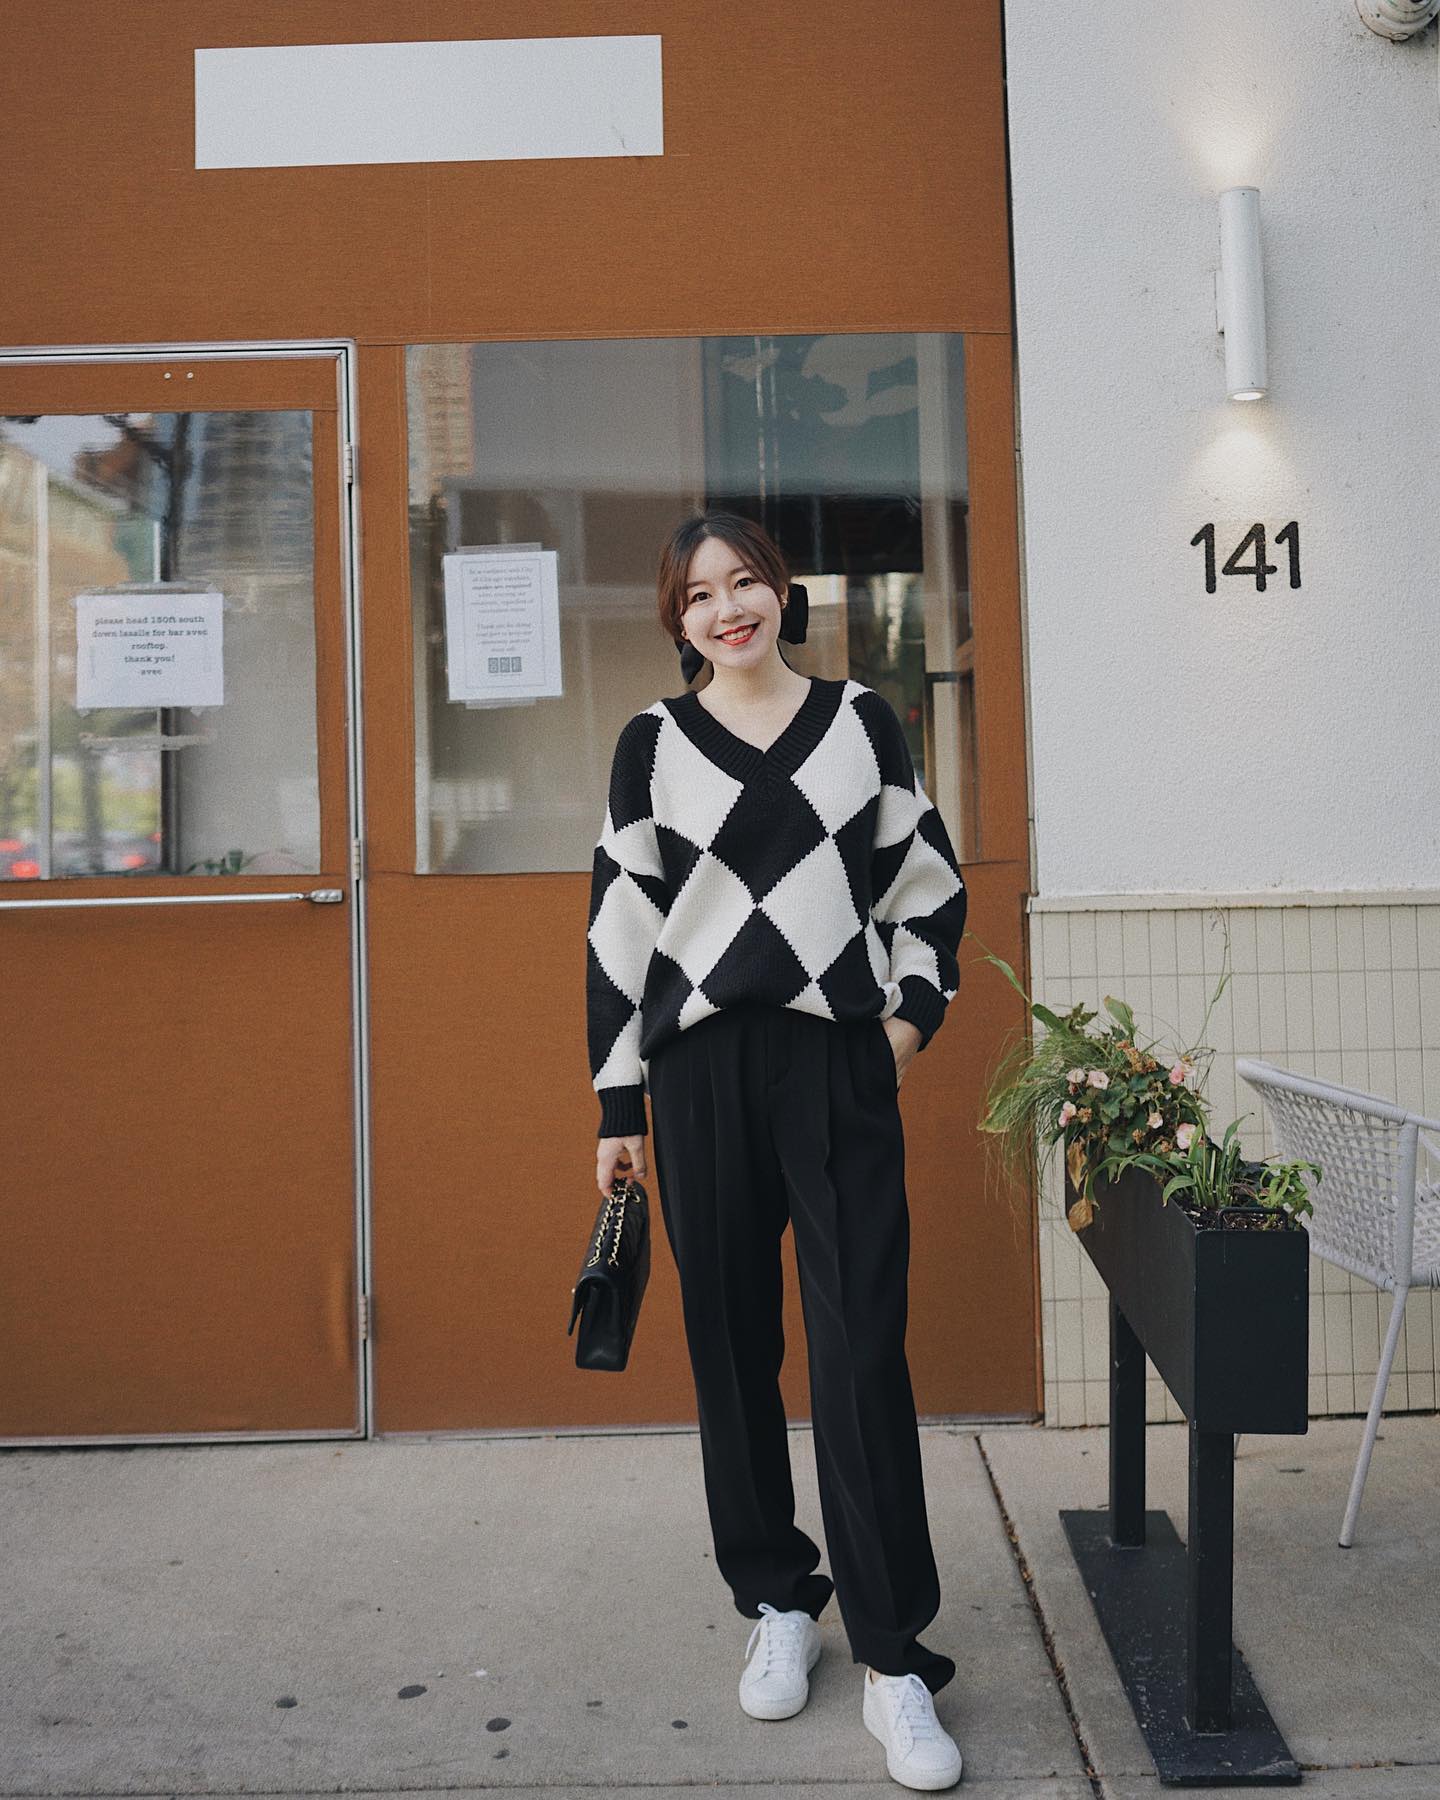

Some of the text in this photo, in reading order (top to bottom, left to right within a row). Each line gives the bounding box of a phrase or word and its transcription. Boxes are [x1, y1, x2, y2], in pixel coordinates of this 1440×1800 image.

[1190, 521, 1301, 594] 141
[95, 615, 205, 626] please head 150ft south
[92, 630, 117, 638] down
[152, 629, 165, 637] for
[124, 654, 176, 664] thank you!
